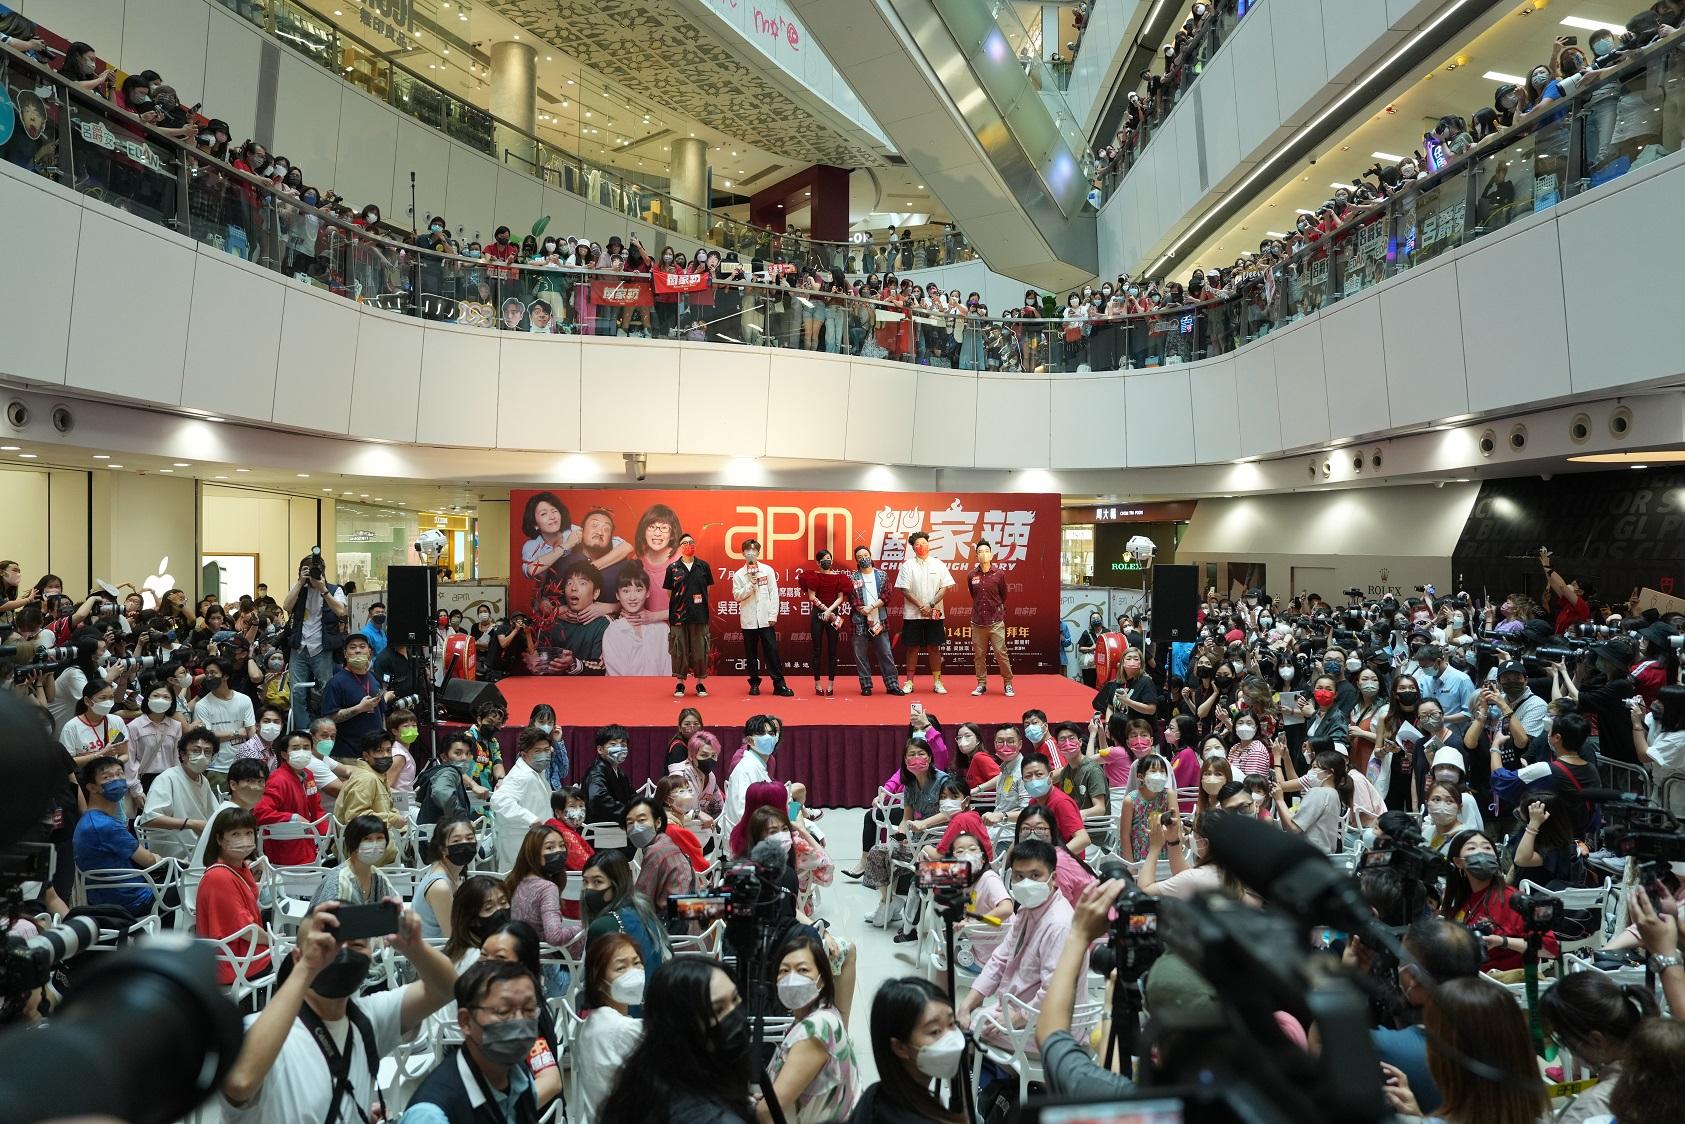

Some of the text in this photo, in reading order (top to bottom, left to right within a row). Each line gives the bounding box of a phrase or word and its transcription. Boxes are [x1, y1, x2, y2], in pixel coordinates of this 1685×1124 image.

[128, 143, 159, 170] EDAN
[870, 497, 1037, 562] 闔家辣
[1368, 585, 1402, 596] ROLEX
[944, 626, 1030, 638] 14日 拜年
